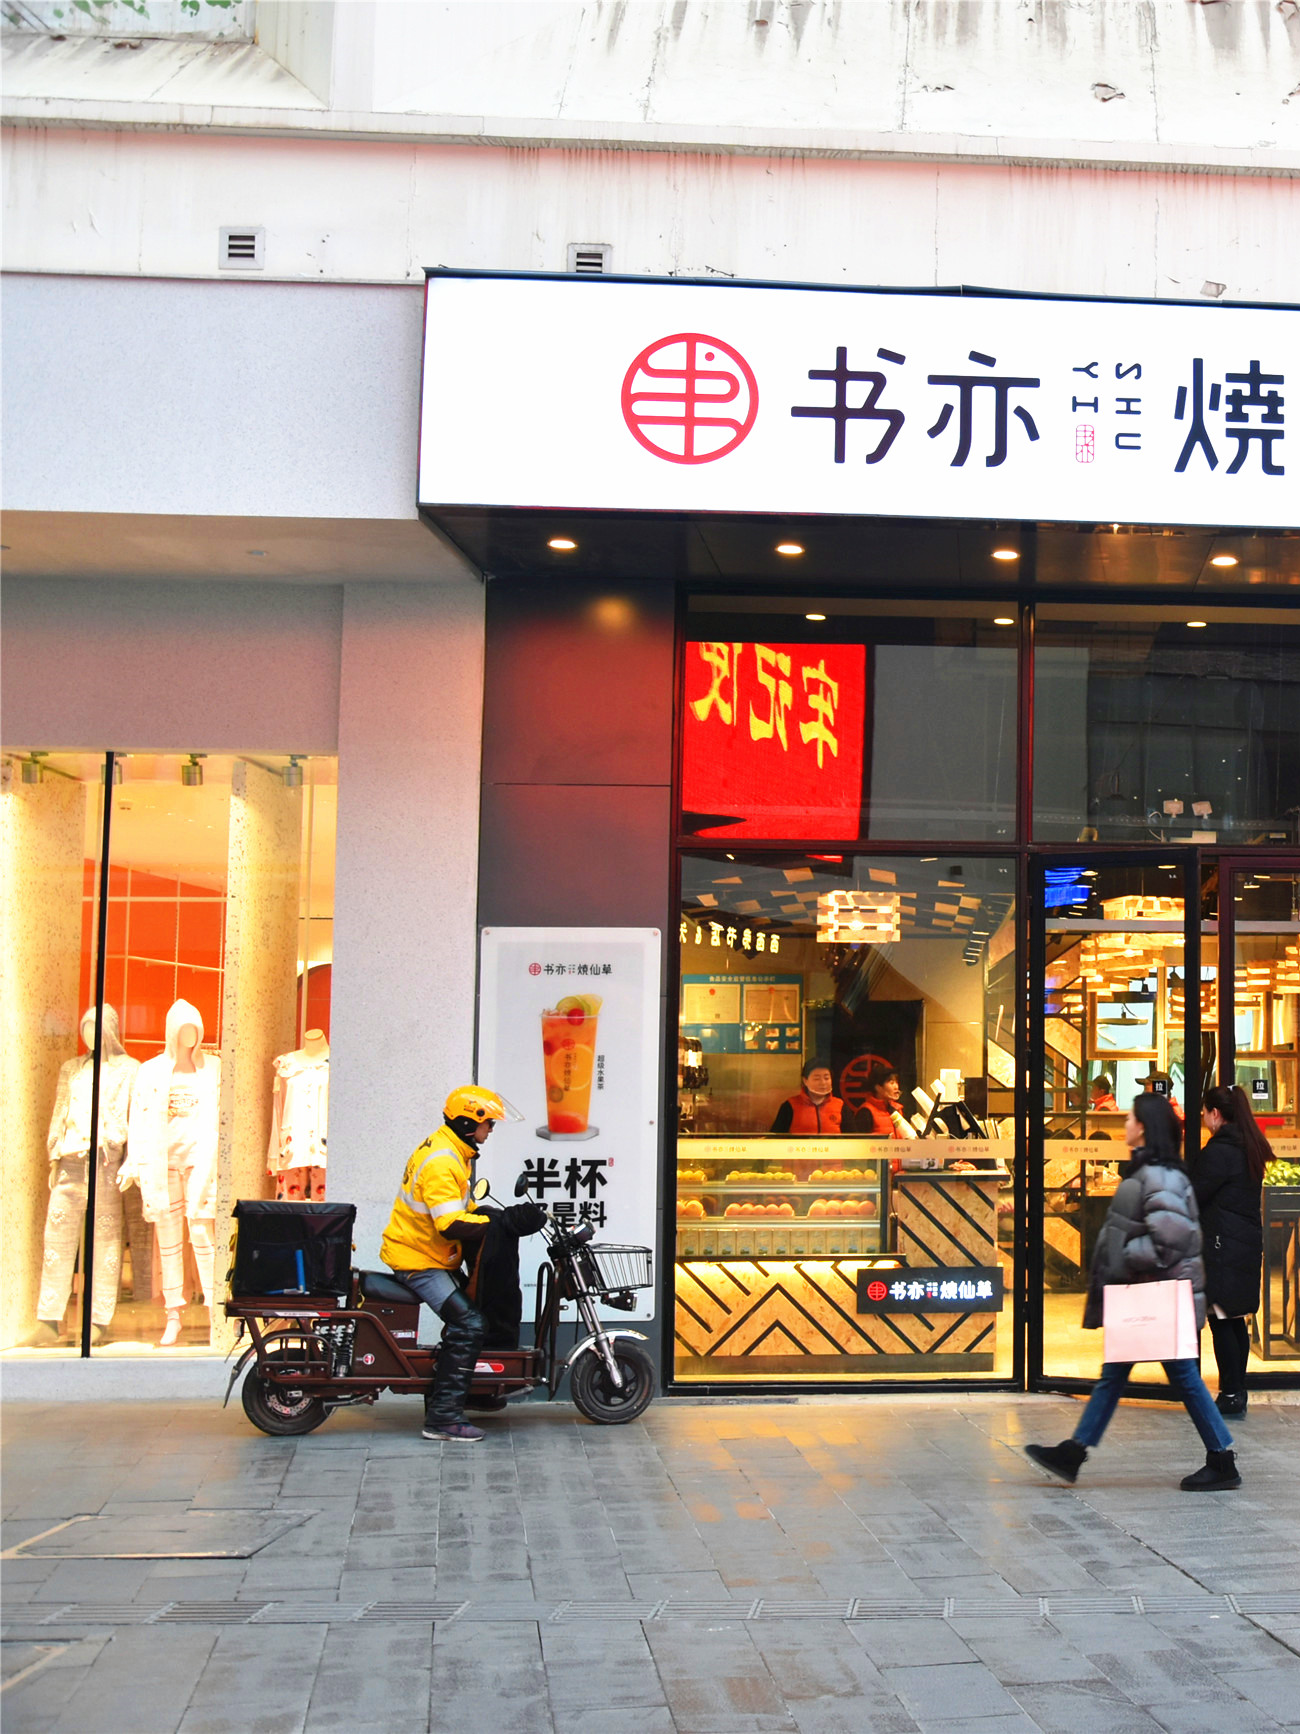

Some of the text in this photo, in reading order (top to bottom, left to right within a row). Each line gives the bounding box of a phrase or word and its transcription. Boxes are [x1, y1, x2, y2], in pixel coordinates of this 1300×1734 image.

[791, 346, 1040, 467] 书亦
[1071, 361, 1099, 412] YI
[1115, 362, 1141, 451] SHU
[1155, 1081, 1163, 1091] 拉
[1255, 1081, 1265, 1091] 拉
[522, 1157, 608, 1200] 半杯
[889, 1281, 925, 1300] 书亦
